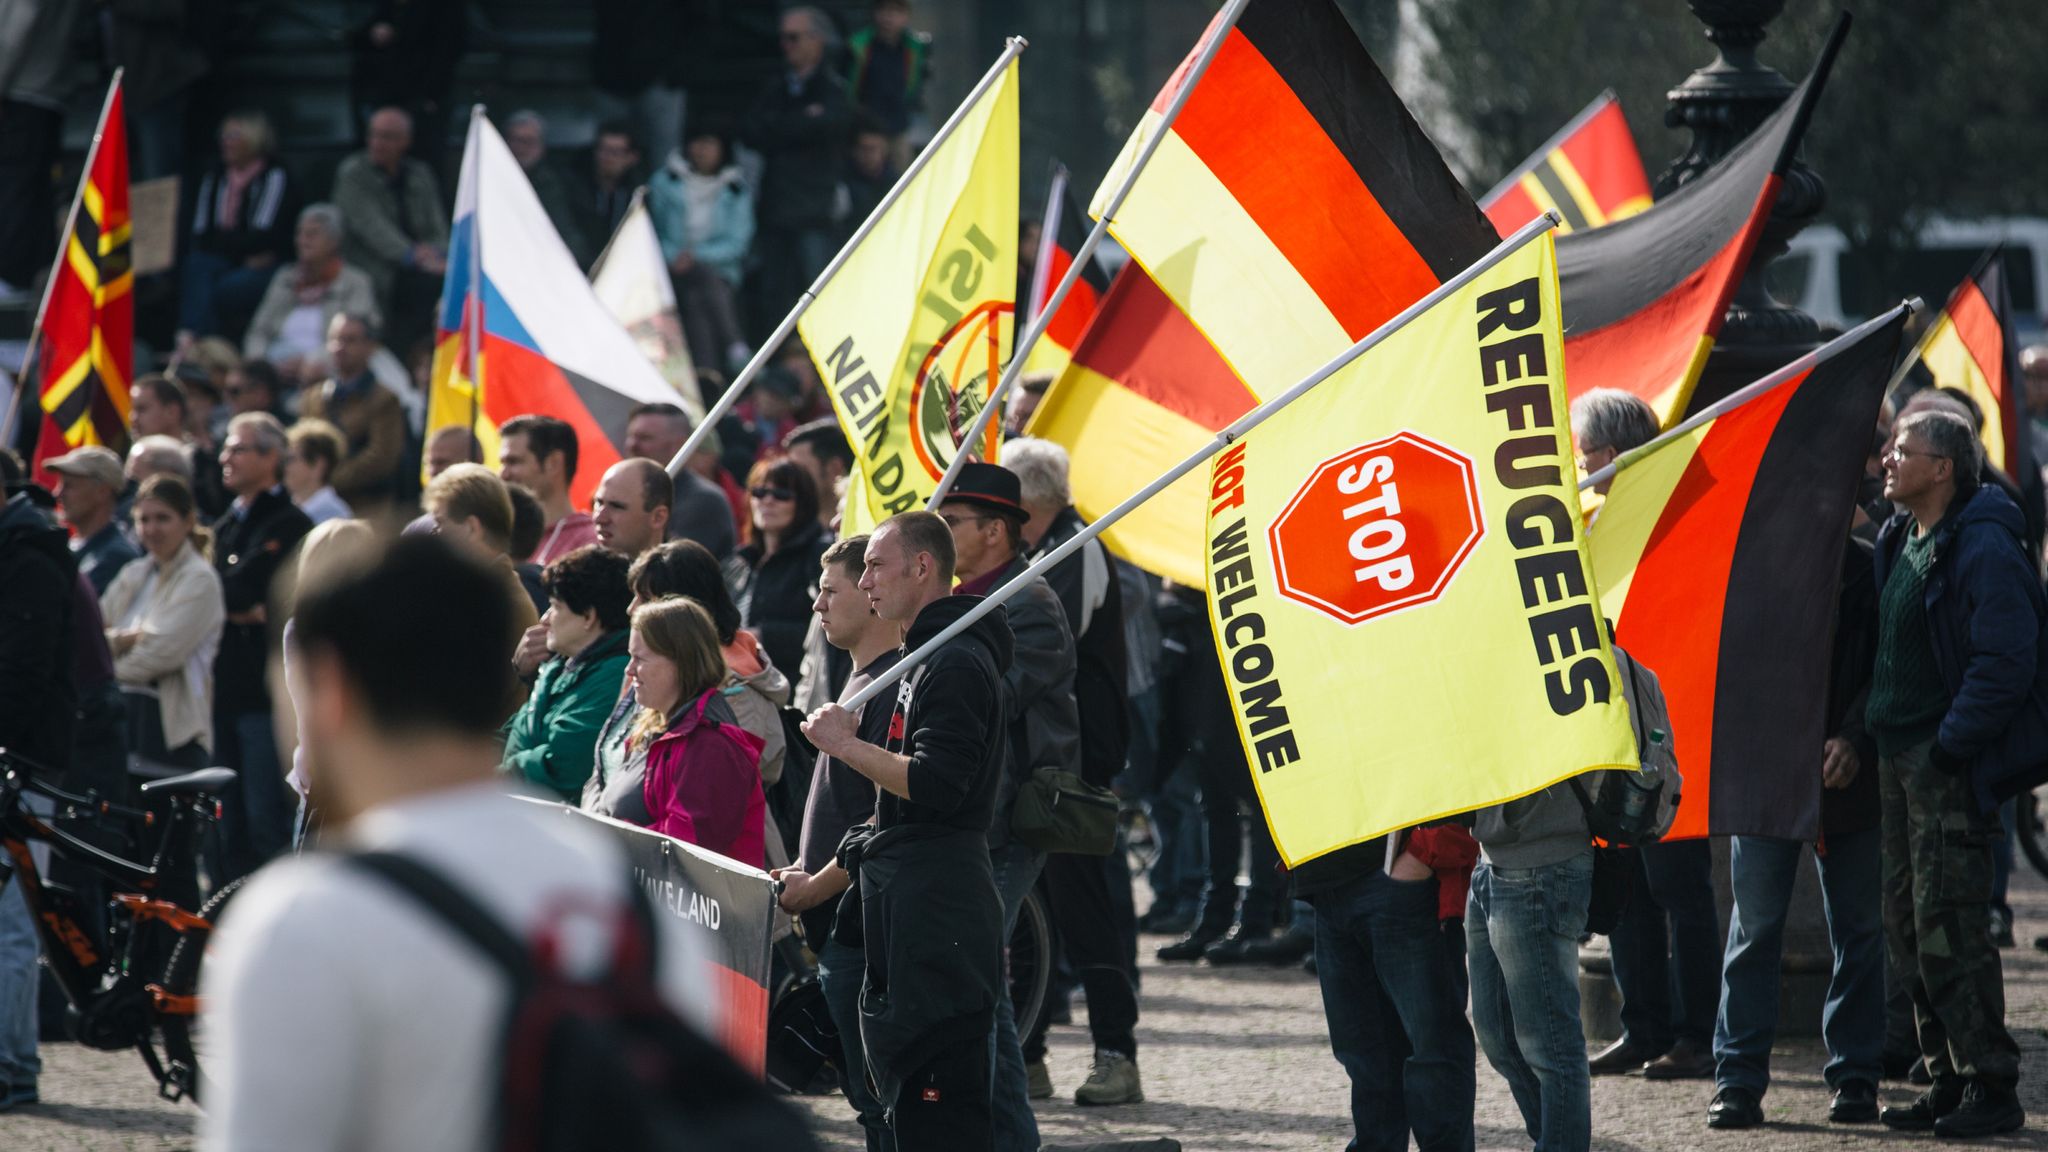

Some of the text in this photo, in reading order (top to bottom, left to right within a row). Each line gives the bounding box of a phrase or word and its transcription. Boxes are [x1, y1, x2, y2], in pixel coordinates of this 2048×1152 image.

[871, 452, 918, 516] DA
[1336, 455, 1415, 592] STOP
[1476, 277, 1612, 717] REFUGEES
[1211, 441, 1301, 774] NOT WELCOME
